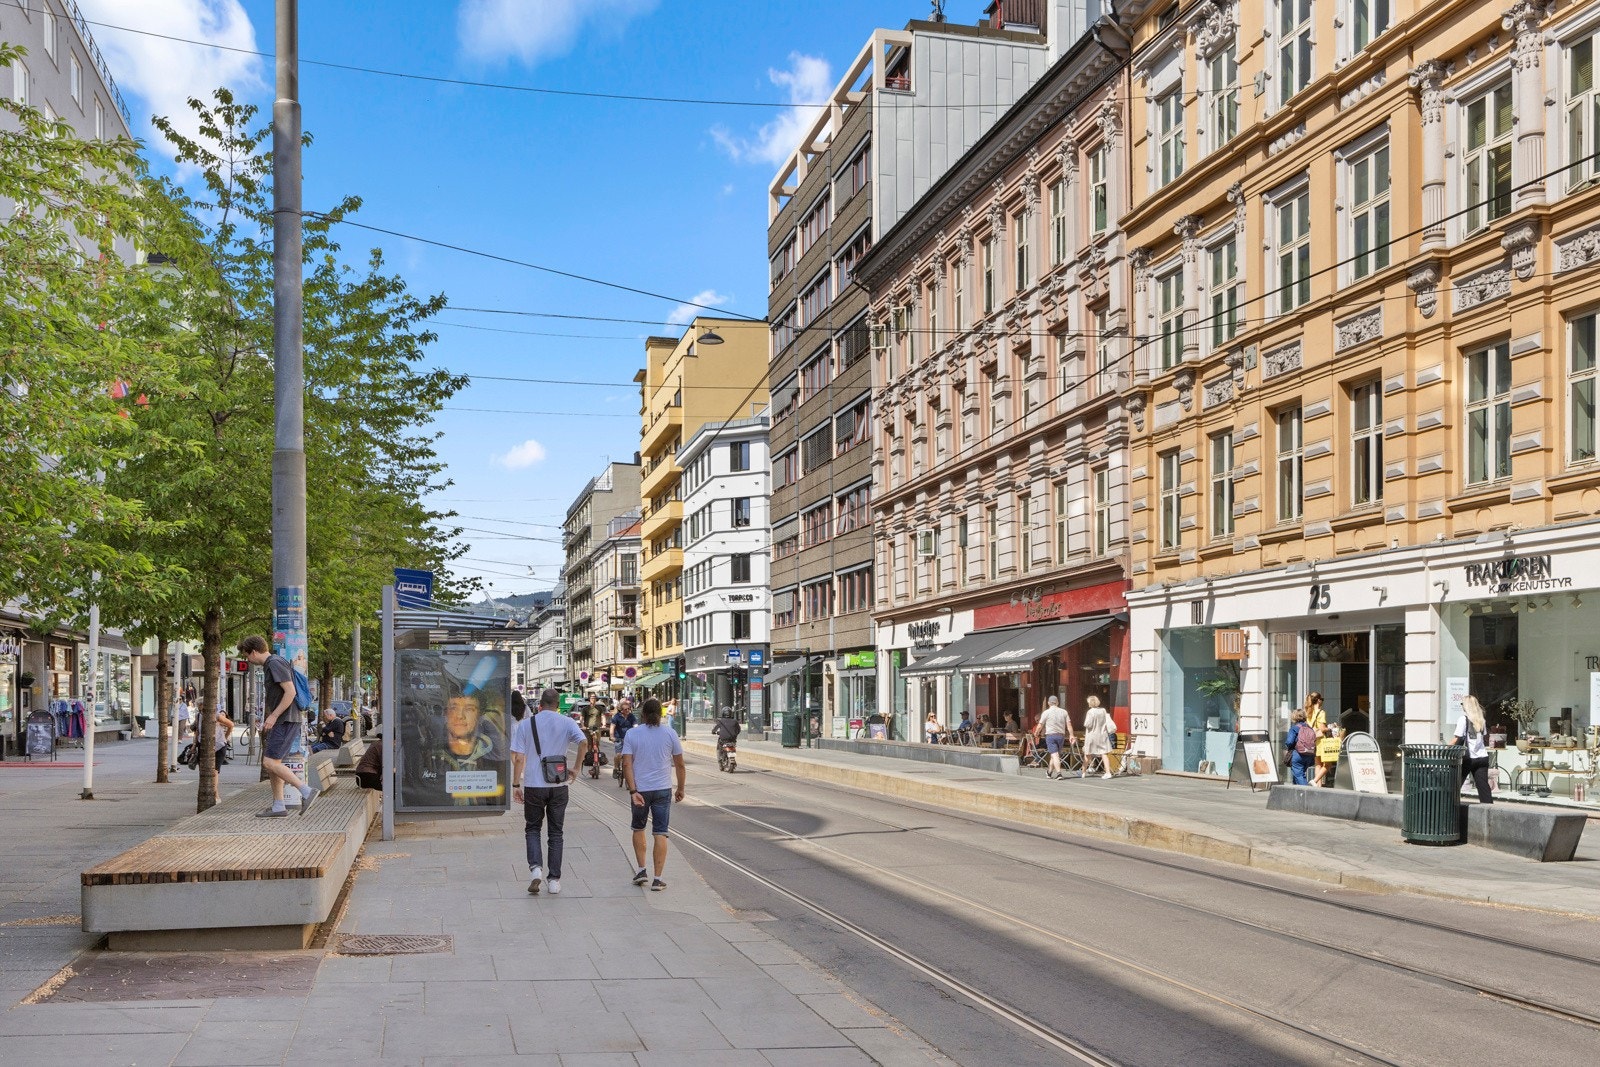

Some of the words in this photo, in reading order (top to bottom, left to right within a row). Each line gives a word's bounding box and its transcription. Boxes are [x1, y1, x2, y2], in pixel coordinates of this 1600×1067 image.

[1464, 555, 1552, 583] TRAKTØREN
[1489, 577, 1573, 594] KJØKKENUTSTYR
[1310, 585, 1331, 609] 25
[1358, 767, 1377, 776] -30%
